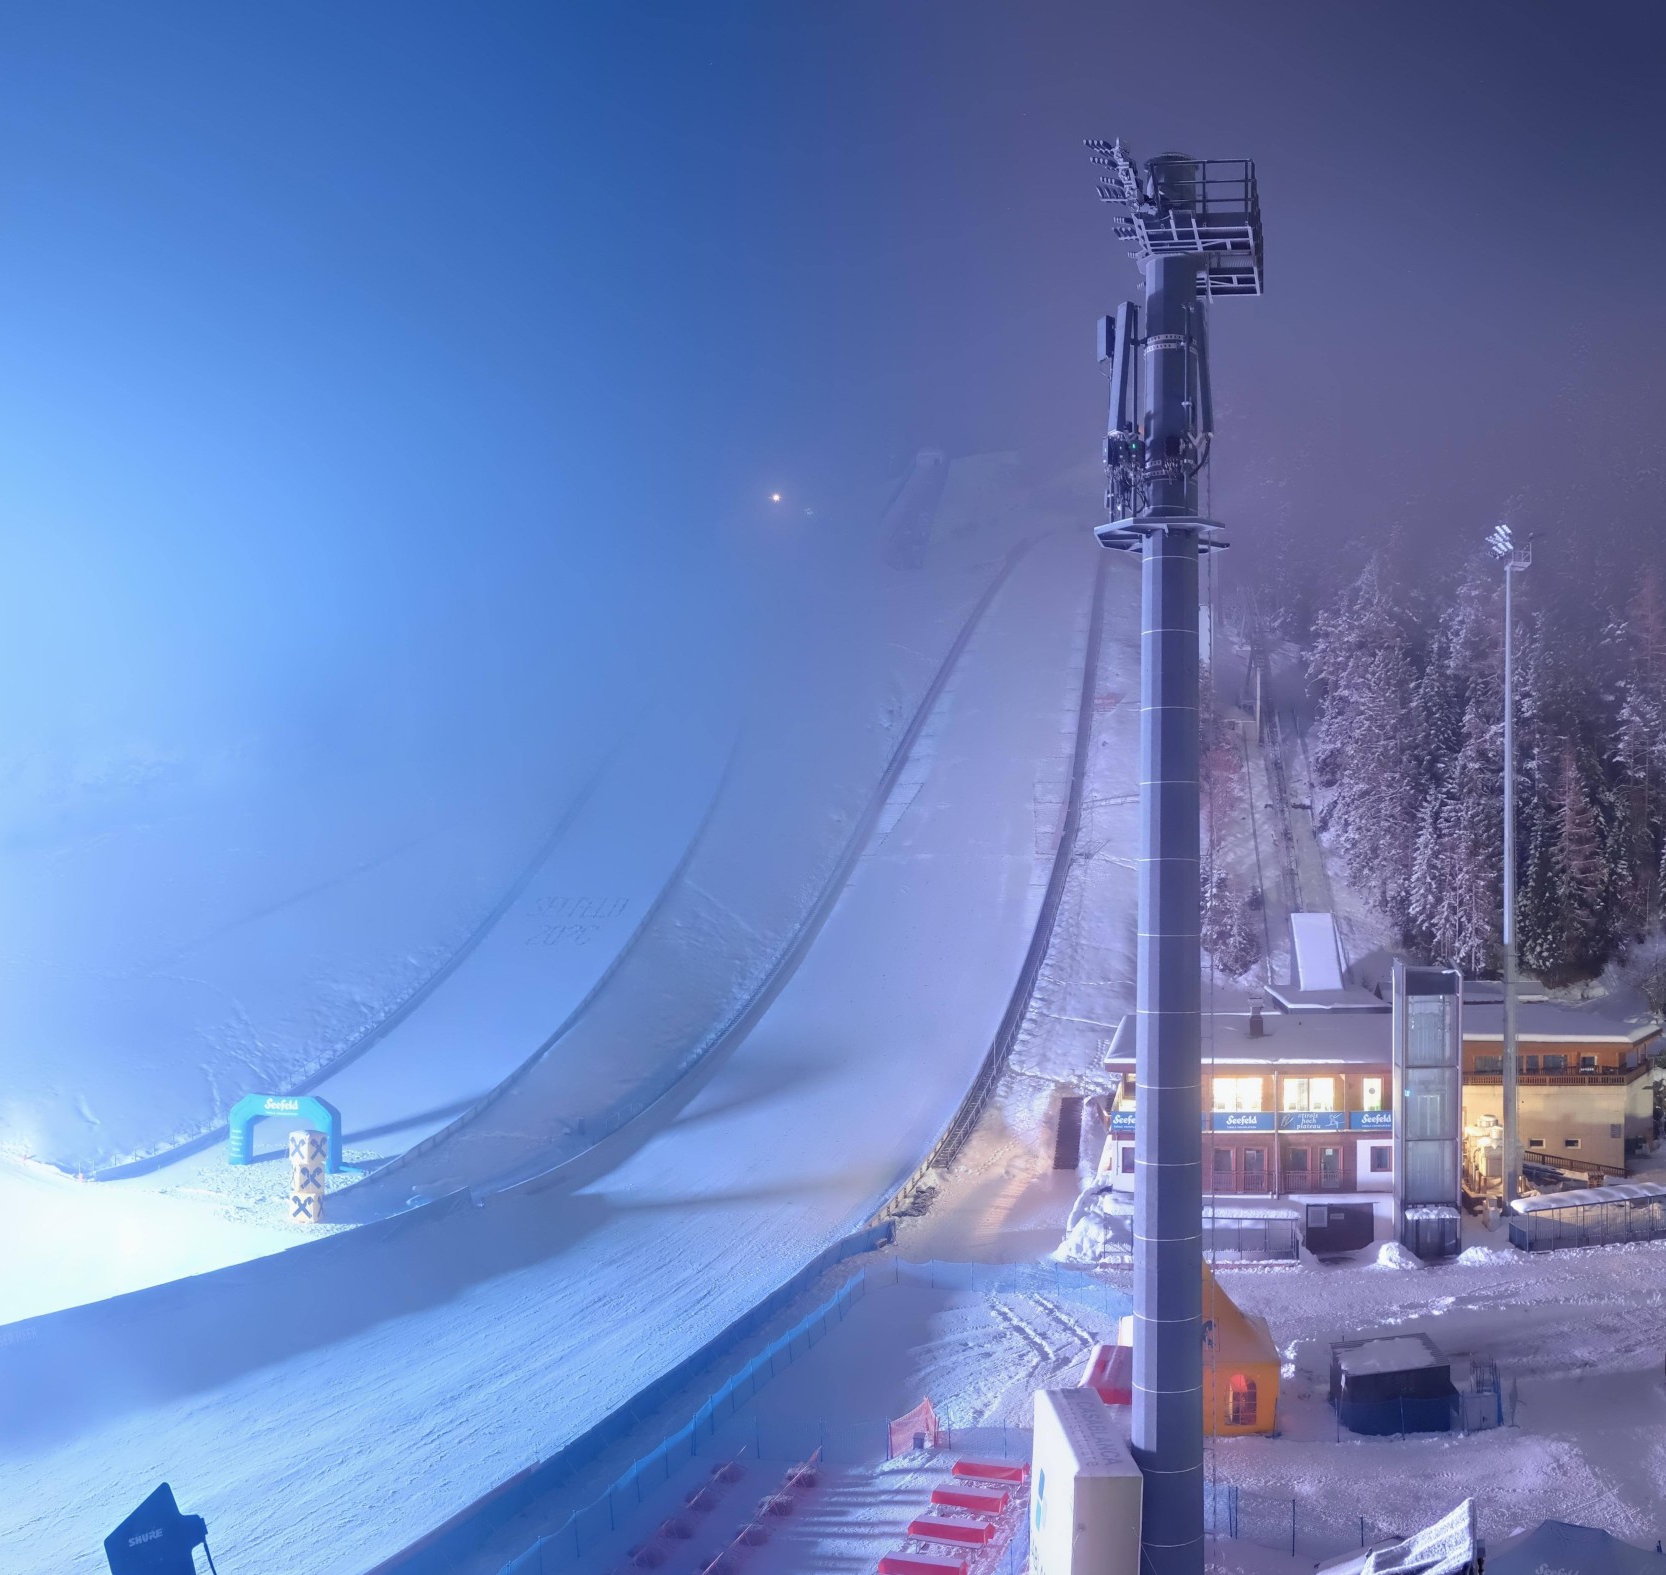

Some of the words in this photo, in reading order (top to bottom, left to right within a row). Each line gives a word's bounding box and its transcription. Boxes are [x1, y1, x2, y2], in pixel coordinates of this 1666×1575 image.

[264, 1097, 299, 1111] Seefeld
[1112, 1114, 1135, 1125] Seefe
[1225, 1115, 1258, 1126] Seefeld
[1361, 1113, 1392, 1125] Seefeld
[1076, 1400, 1124, 1467] CASABLANCA
[128, 1528, 163, 1547] SHURE
